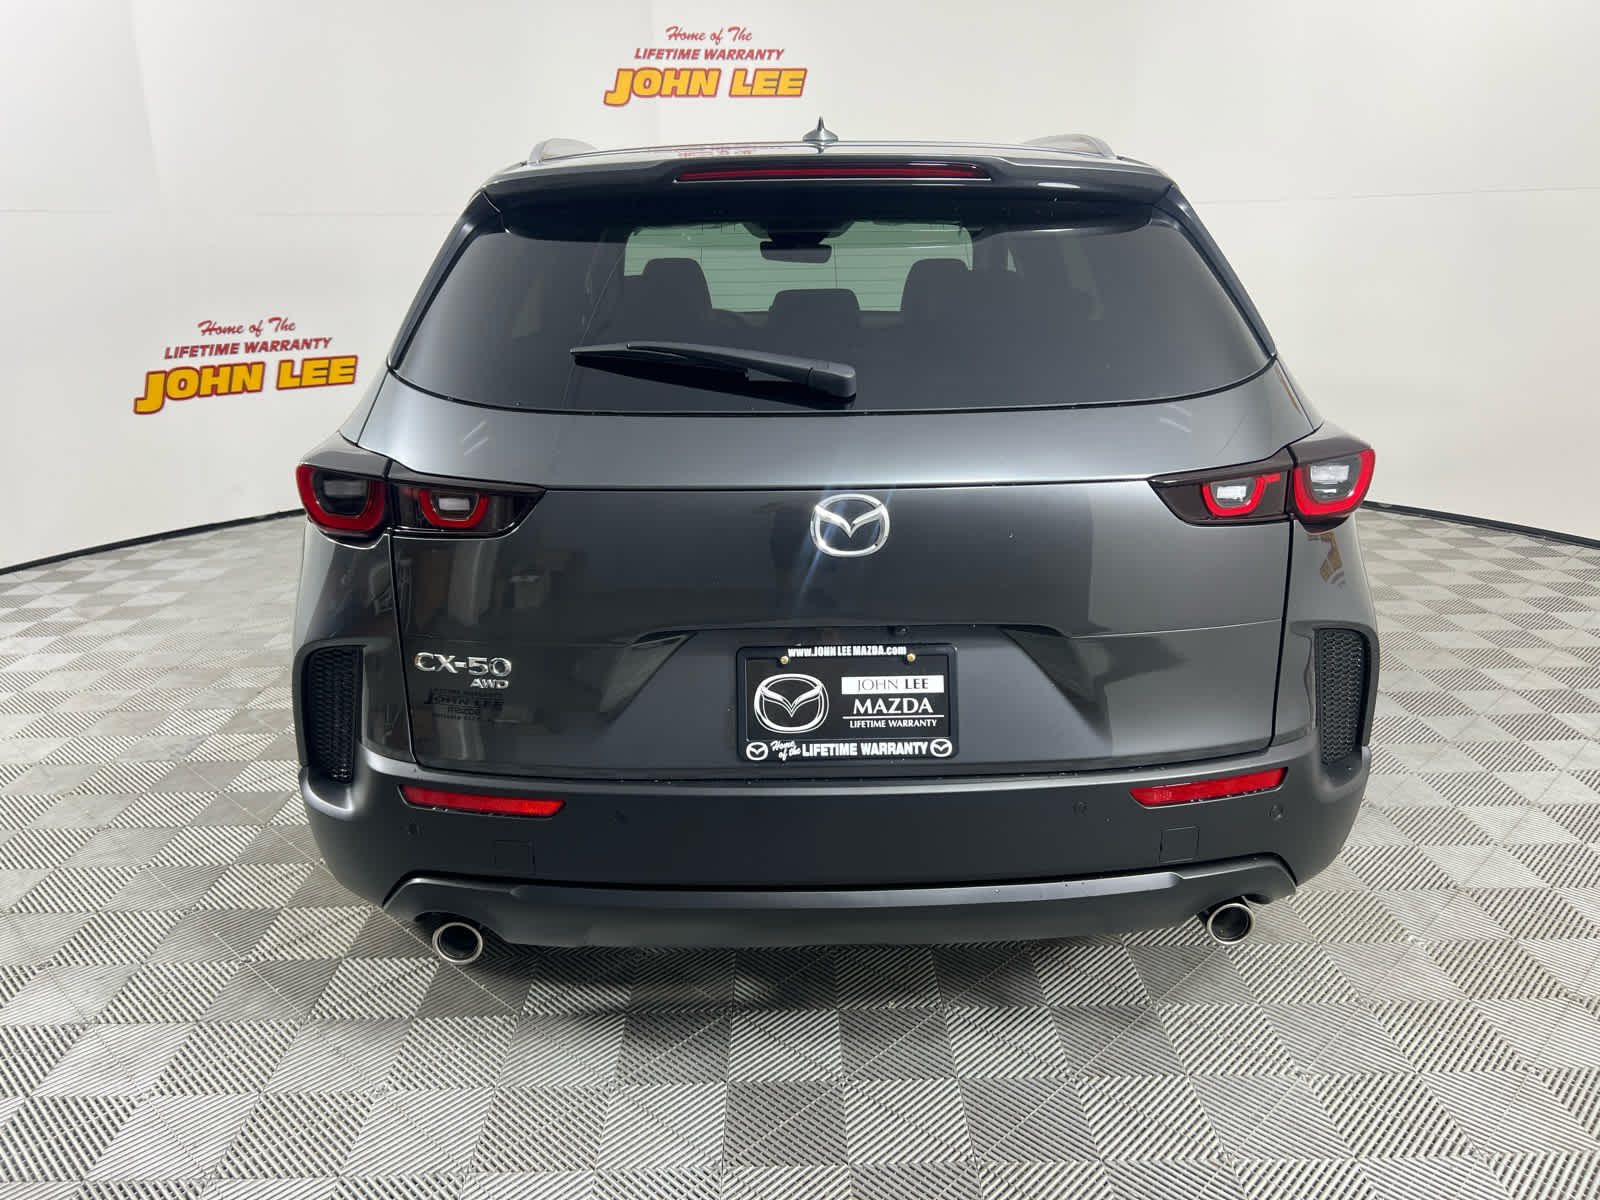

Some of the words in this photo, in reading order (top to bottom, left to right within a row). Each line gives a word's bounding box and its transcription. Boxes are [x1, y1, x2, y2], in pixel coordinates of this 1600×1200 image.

[665, 26, 706, 41] Home
[710, 28, 724, 45] of
[727, 26, 753, 41] The
[633, 48, 700, 60] LIFETIME
[704, 48, 784, 60] WARRANTY
[603, 67, 722, 107] JOHN
[729, 68, 808, 98] LEE
[197, 320, 244, 336] Home
[249, 320, 264, 337] of
[268, 317, 296, 333] The
[164, 341, 240, 360] LIFETIME
[244, 337, 332, 354] WARRANTY
[133, 361, 266, 415] JOHN
[276, 354, 358, 390] LEE
[414, 651, 512, 677] CX-50
[470, 678, 509, 689] AWD
[857, 678, 898, 692] JOHN
[905, 677, 929, 690] LEE
[853, 697, 934, 714] MAZDA
[849, 720, 886, 729] LIFETIME
[888, 719, 937, 728] WARRANTY
[770, 740, 796, 751] Home
[778, 750, 788, 761] of
[788, 746, 801, 757] the
[802, 743, 858, 757] LIFETIME
[861, 742, 929, 756] WARRANTY
